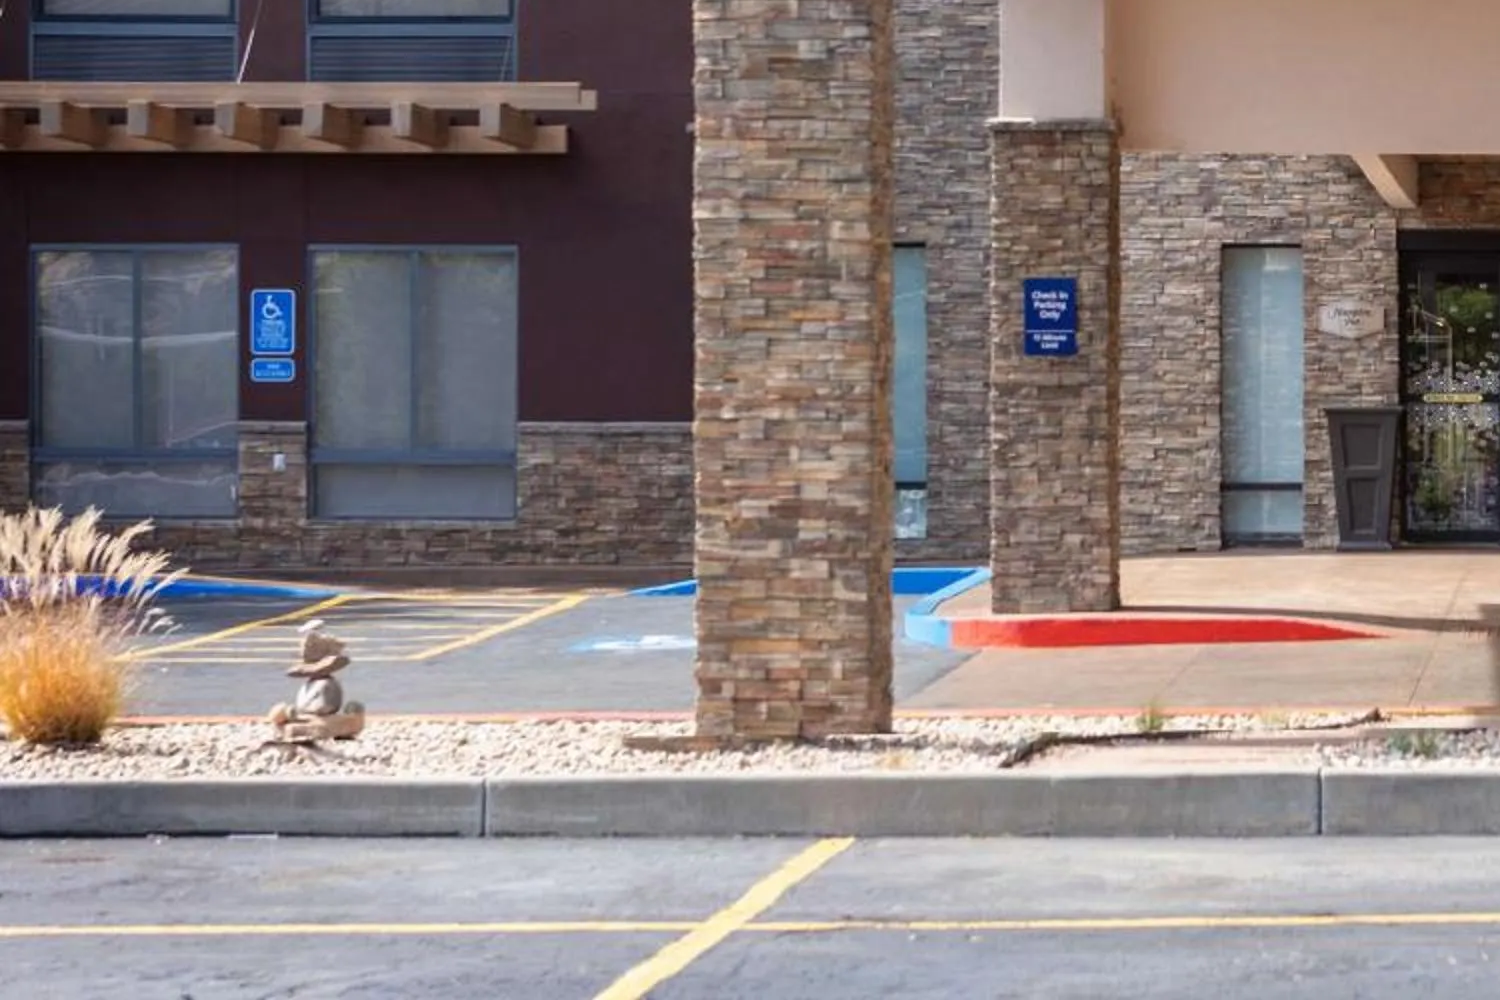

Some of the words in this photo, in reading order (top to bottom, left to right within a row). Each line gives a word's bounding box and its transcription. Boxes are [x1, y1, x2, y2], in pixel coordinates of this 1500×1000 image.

[1031, 290, 1057, 300] Check
[1058, 290, 1069, 300] In
[1033, 301, 1067, 312] Parking
[1039, 310, 1061, 321] Only
